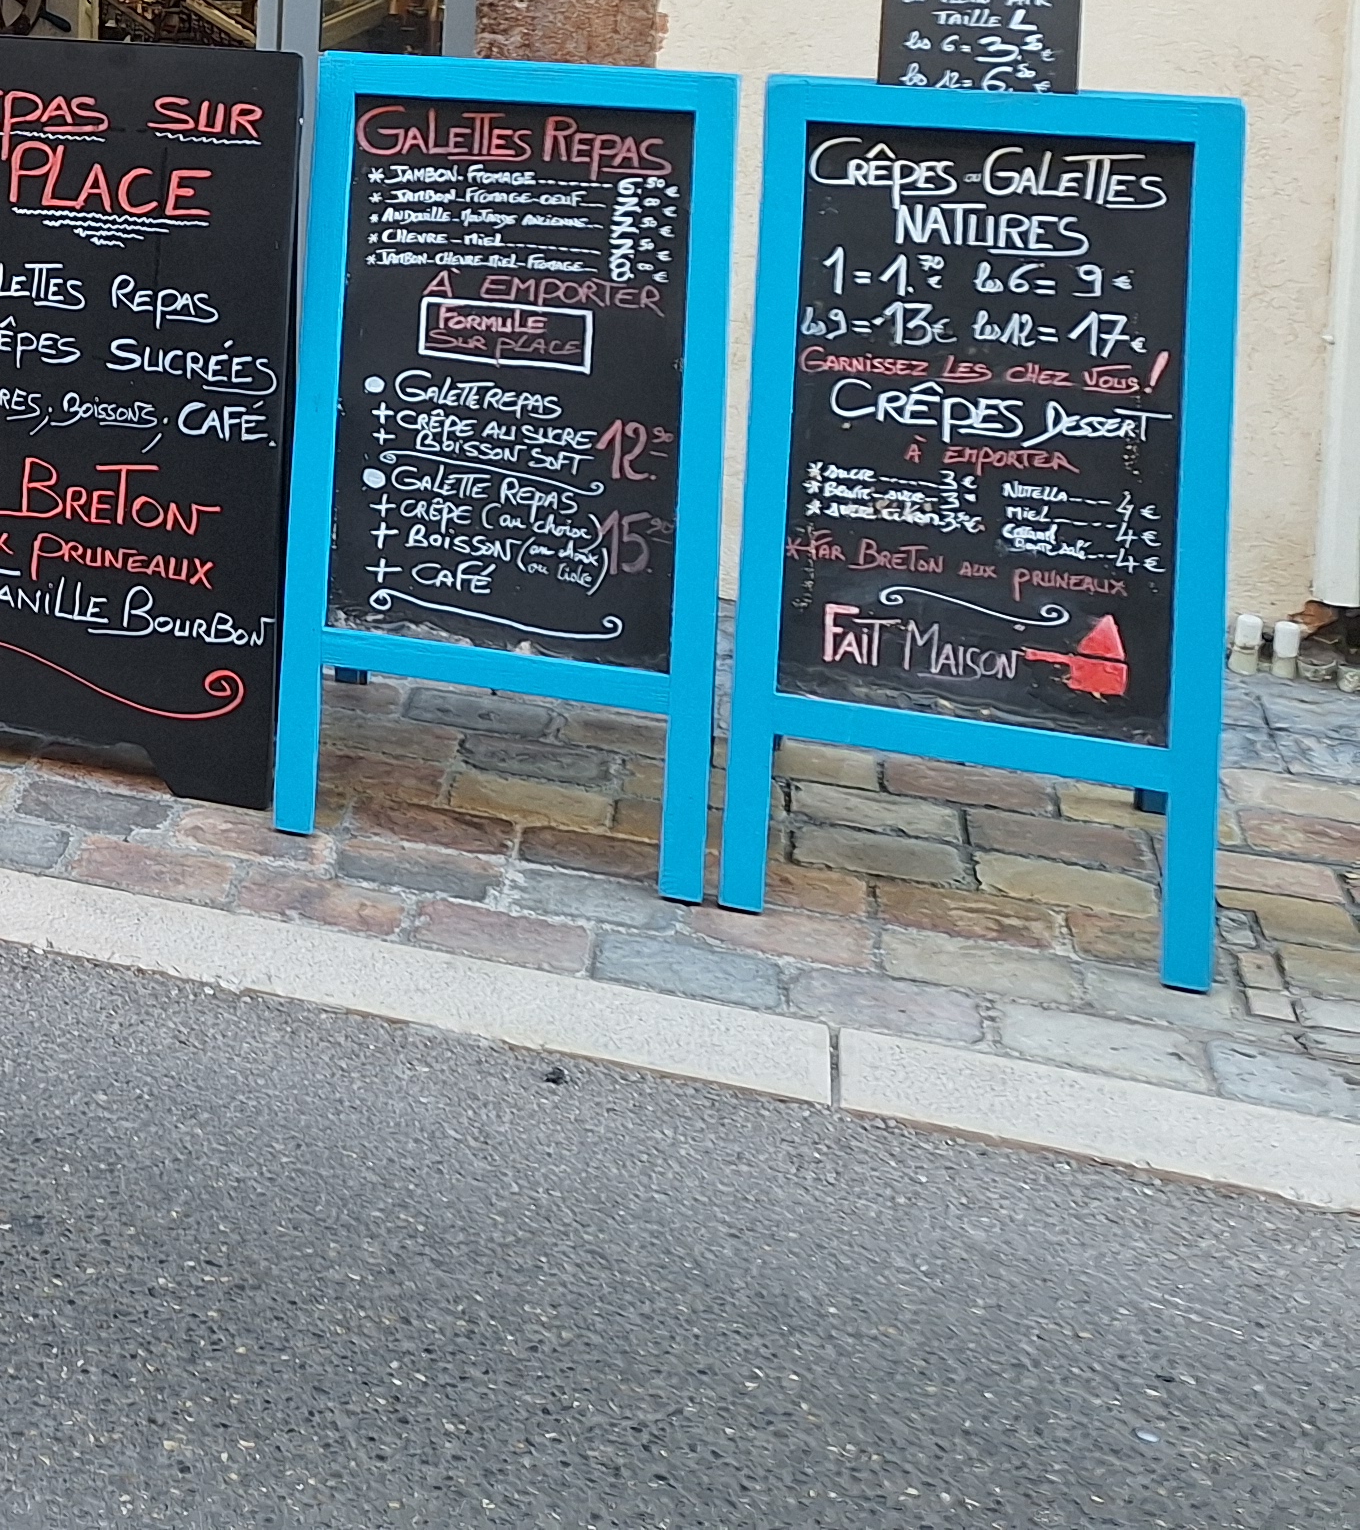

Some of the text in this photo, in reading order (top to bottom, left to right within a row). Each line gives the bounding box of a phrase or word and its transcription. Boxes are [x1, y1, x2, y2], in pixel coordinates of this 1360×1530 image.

[1007, 9, 1038, 31] L
[147, 97, 263, 138] SUR
[355, 105, 672, 180] GALETTES REPAS
[9, 141, 212, 216] PLACE
[809, 137, 958, 208] CRÊPES
[982, 147, 1168, 208] GALETTES
[894, 204, 1090, 256] NATURES
[111, 275, 218, 329] REPAS
[439, 304, 547, 333] FORMULE
[480, 275, 665, 317] EMPORTER
[106, 339, 277, 394] SUCRÉES
[426, 330, 581, 367] SUR PLACE
[799, 346, 928, 377] GARNISSEZ
[942, 355, 992, 384] LES
[1005, 363, 1073, 387] CHEZ
[481, 422, 515, 441] AU
[522, 425, 598, 449] SUCRE
[829, 378, 1172, 447] CRÊPES DESSERT
[528, 452, 594, 475] SOFT
[943, 446, 1079, 474] EMPORTER
[391, 465, 578, 520] GALETTE REPAS
[30, 532, 214, 590] PRUNEAUX
[412, 563, 497, 594] CAFÉ
[848, 538, 943, 573] BRETON
[960, 561, 997, 578] AUX
[1013, 569, 1128, 601] PRUNEAUX
[87, 585, 276, 646] BOURBON
[823, 604, 1024, 680] FAIT MAISON
